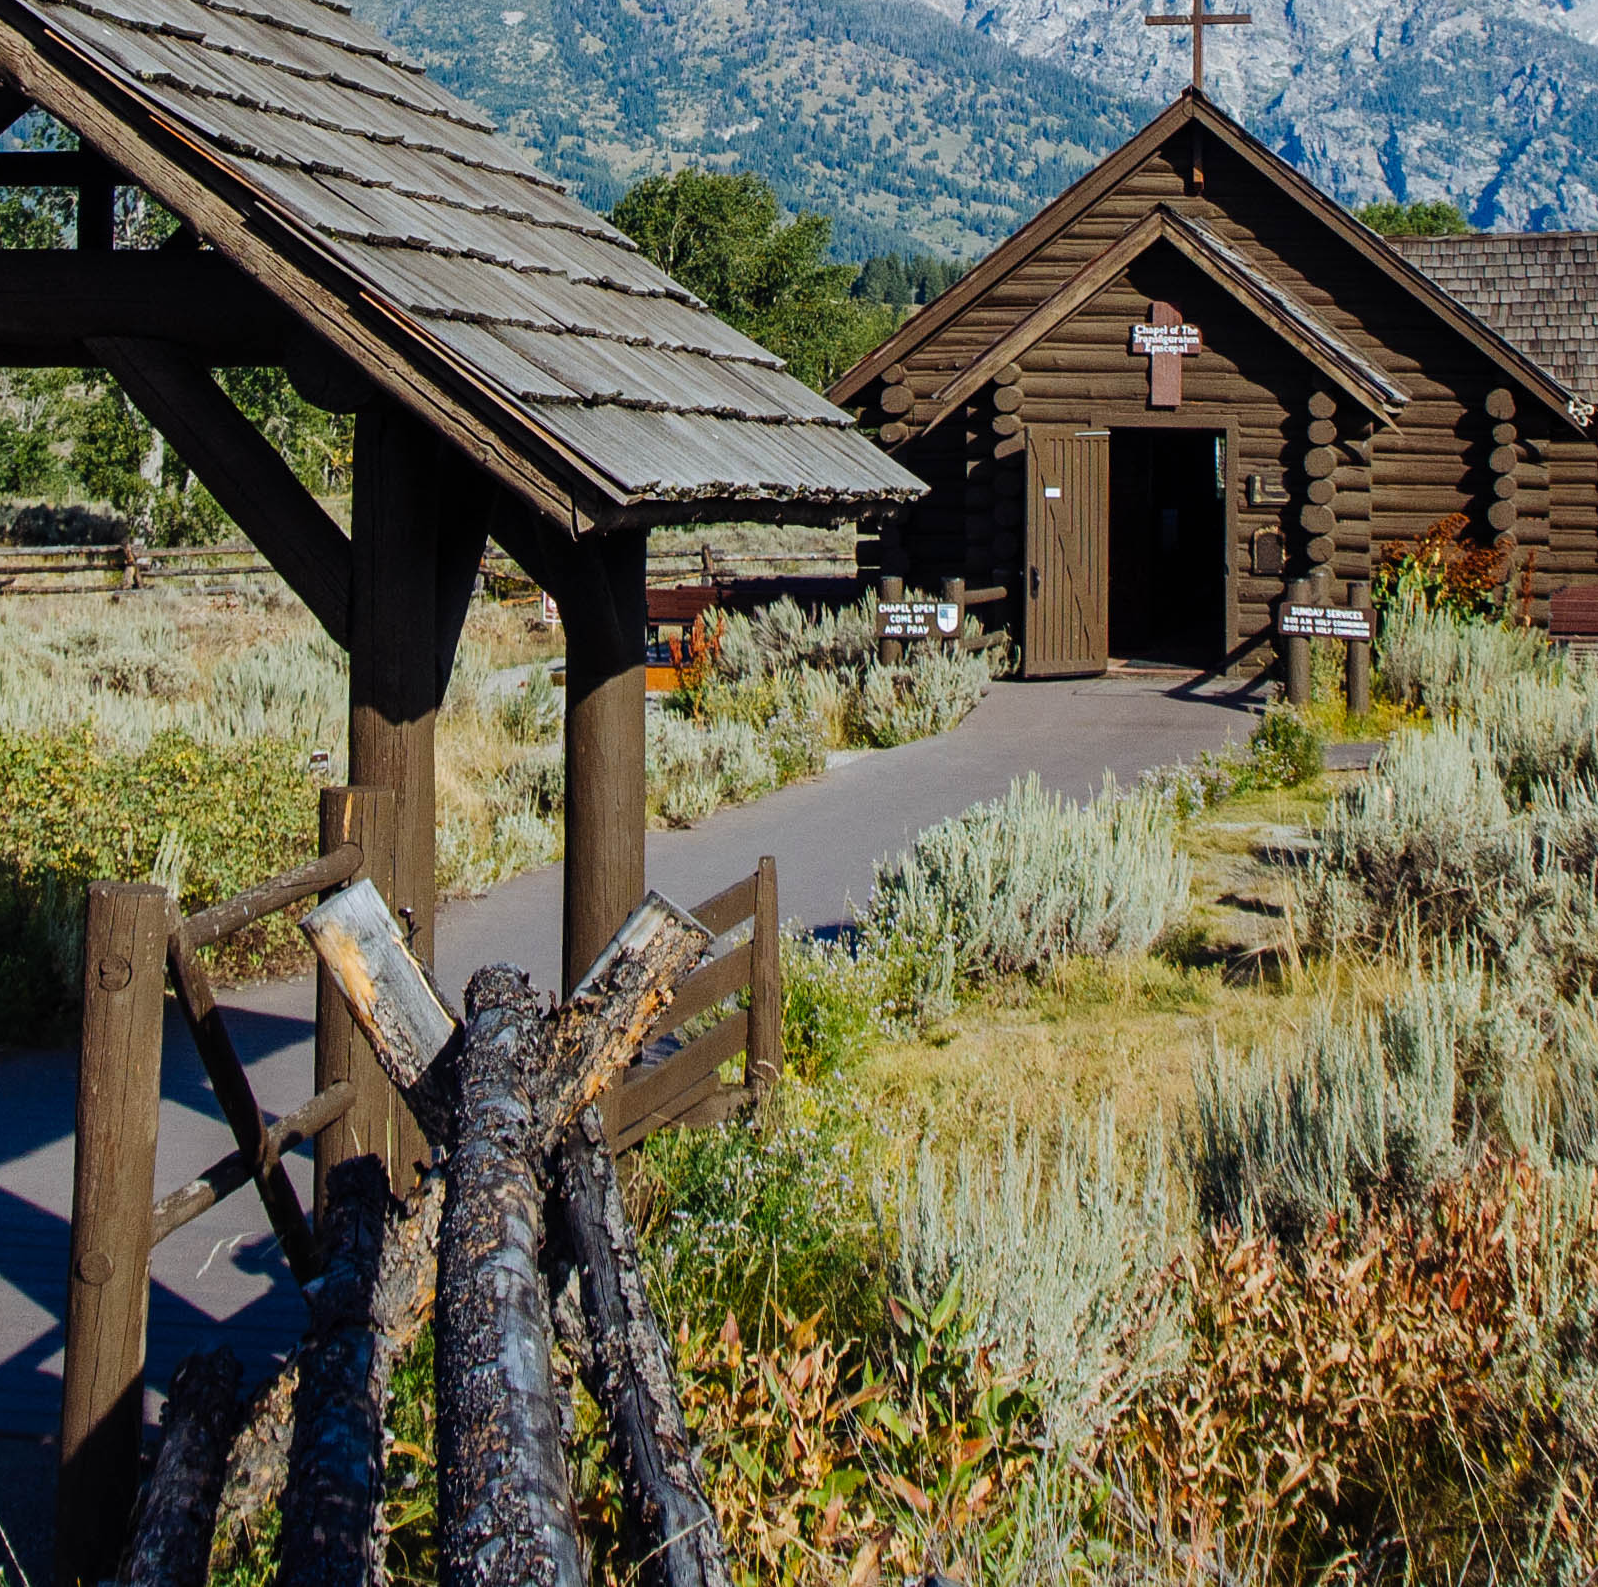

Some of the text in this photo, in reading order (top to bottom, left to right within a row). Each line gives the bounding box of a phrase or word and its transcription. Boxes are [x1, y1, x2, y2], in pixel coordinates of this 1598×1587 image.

[1134, 324, 1199, 337] Chapel of The
[1145, 342, 1188, 355] Episcopal
[878, 603, 936, 613] CHAPEL OPEN
[1291, 605, 1364, 621] SUNDAY SERVICES
[889, 614, 925, 624] COME IN
[1314, 618, 1332, 627] HOLY
[884, 624, 930, 634] AND PRAY
[1315, 626, 1333, 634] HOLY
